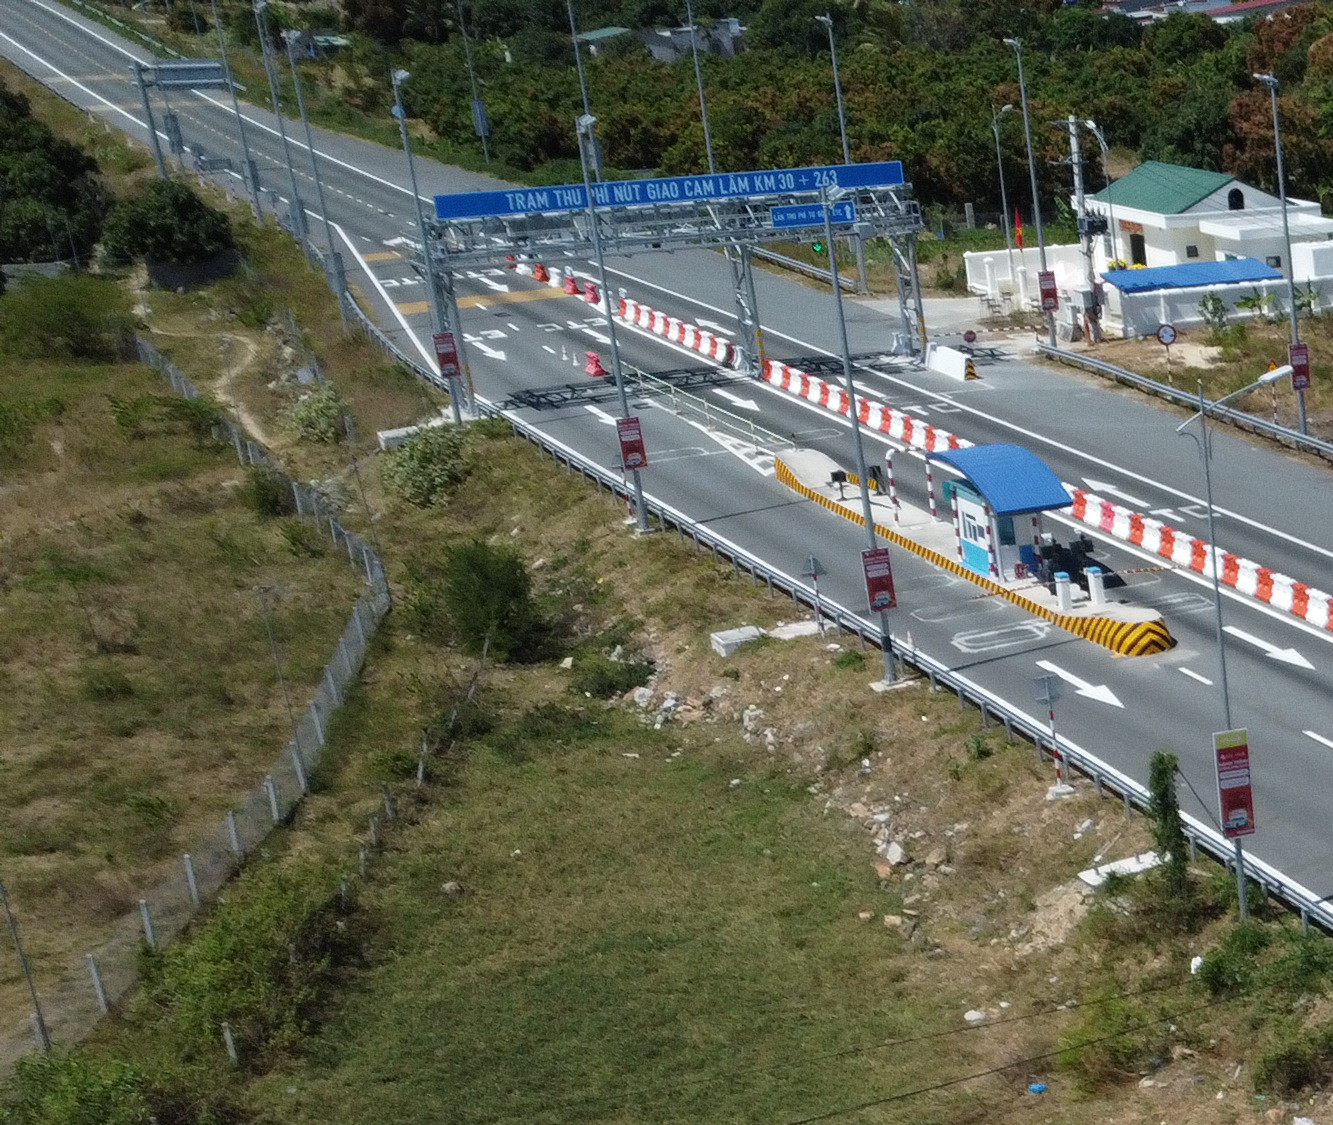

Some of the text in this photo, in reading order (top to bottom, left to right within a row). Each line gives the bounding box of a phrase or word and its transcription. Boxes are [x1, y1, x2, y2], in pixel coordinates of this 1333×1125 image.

[505, 191, 550, 213] TRẠM
[554, 187, 582, 208] THU
[612, 181, 642, 203] NÚT
[646, 181, 680, 201] GIAO
[683, 177, 715, 197] CAM
[718, 174, 750, 194] LÂM
[813, 169, 838, 188] 263
